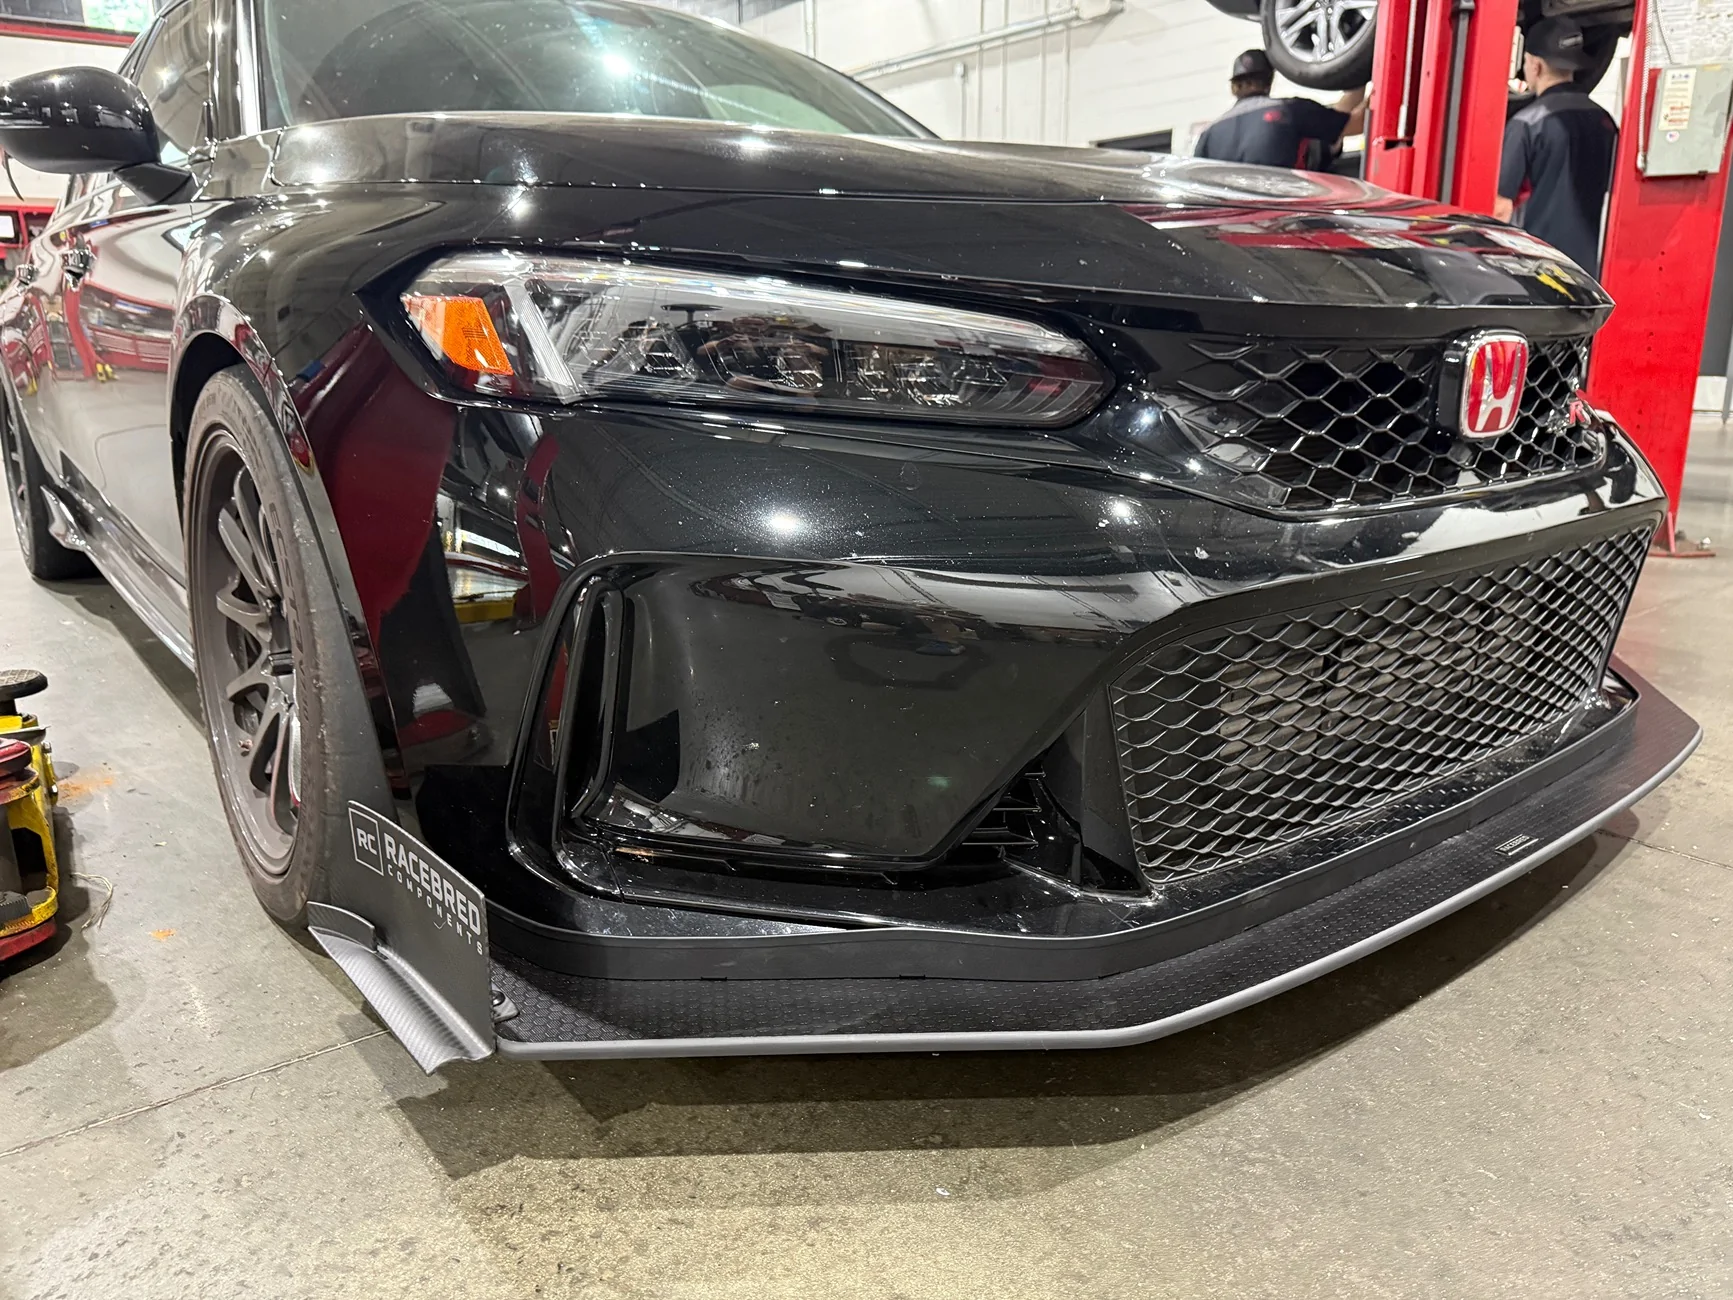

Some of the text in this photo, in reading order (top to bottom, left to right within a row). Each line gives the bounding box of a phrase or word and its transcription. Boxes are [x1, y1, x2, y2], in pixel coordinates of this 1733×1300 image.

[356, 827, 378, 855] RC
[383, 832, 481, 936] RACEBRED
[387, 864, 483, 956] COMPONENTS
